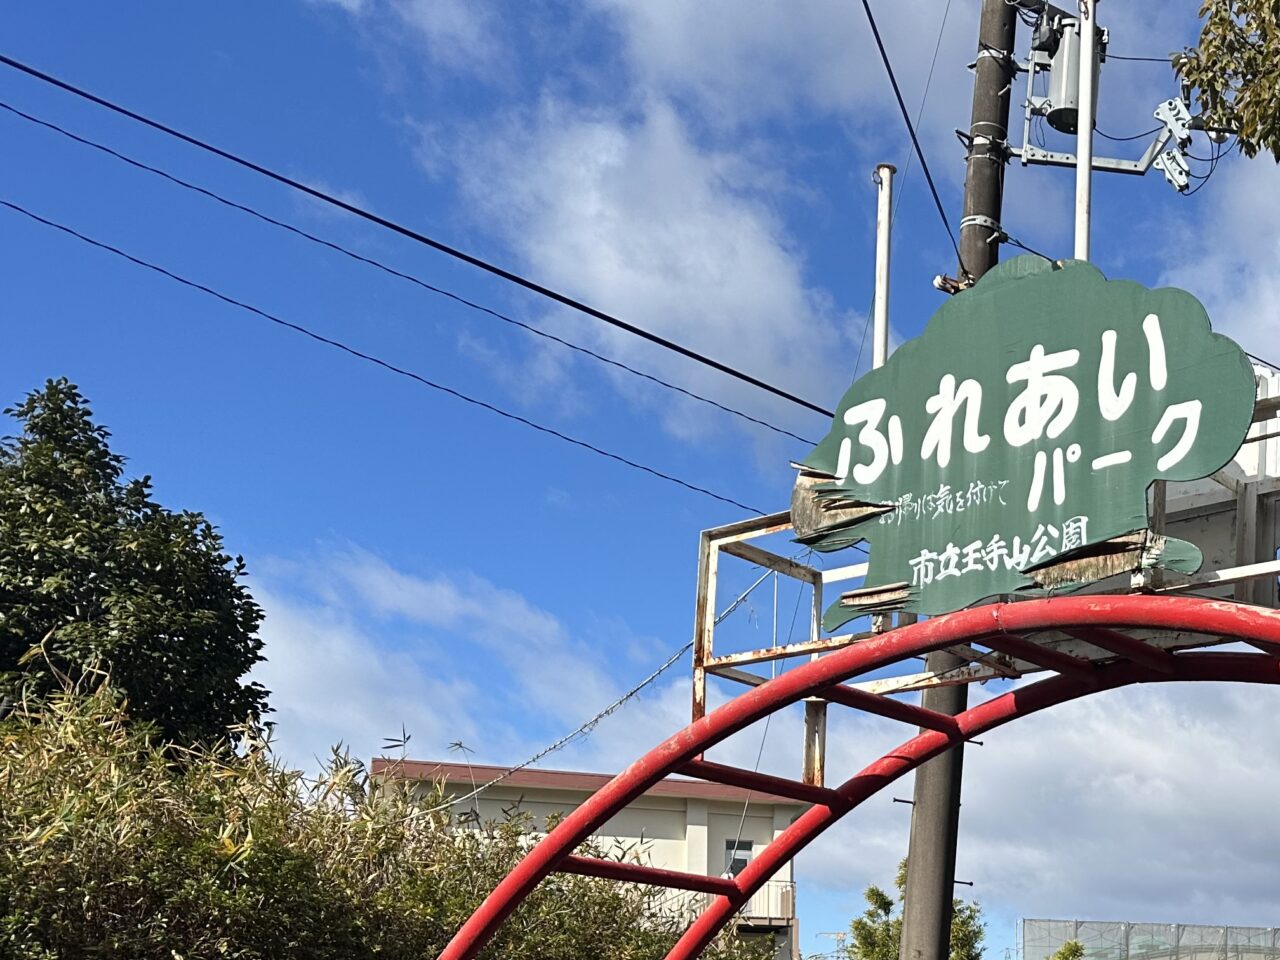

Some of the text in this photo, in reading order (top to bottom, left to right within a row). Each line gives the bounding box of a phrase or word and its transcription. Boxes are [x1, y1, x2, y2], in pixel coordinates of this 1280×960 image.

[836, 313, 1168, 485] ふれあい
[1027, 399, 1203, 513] パーク
[908, 515, 1089, 590] 市立玉手山公園
